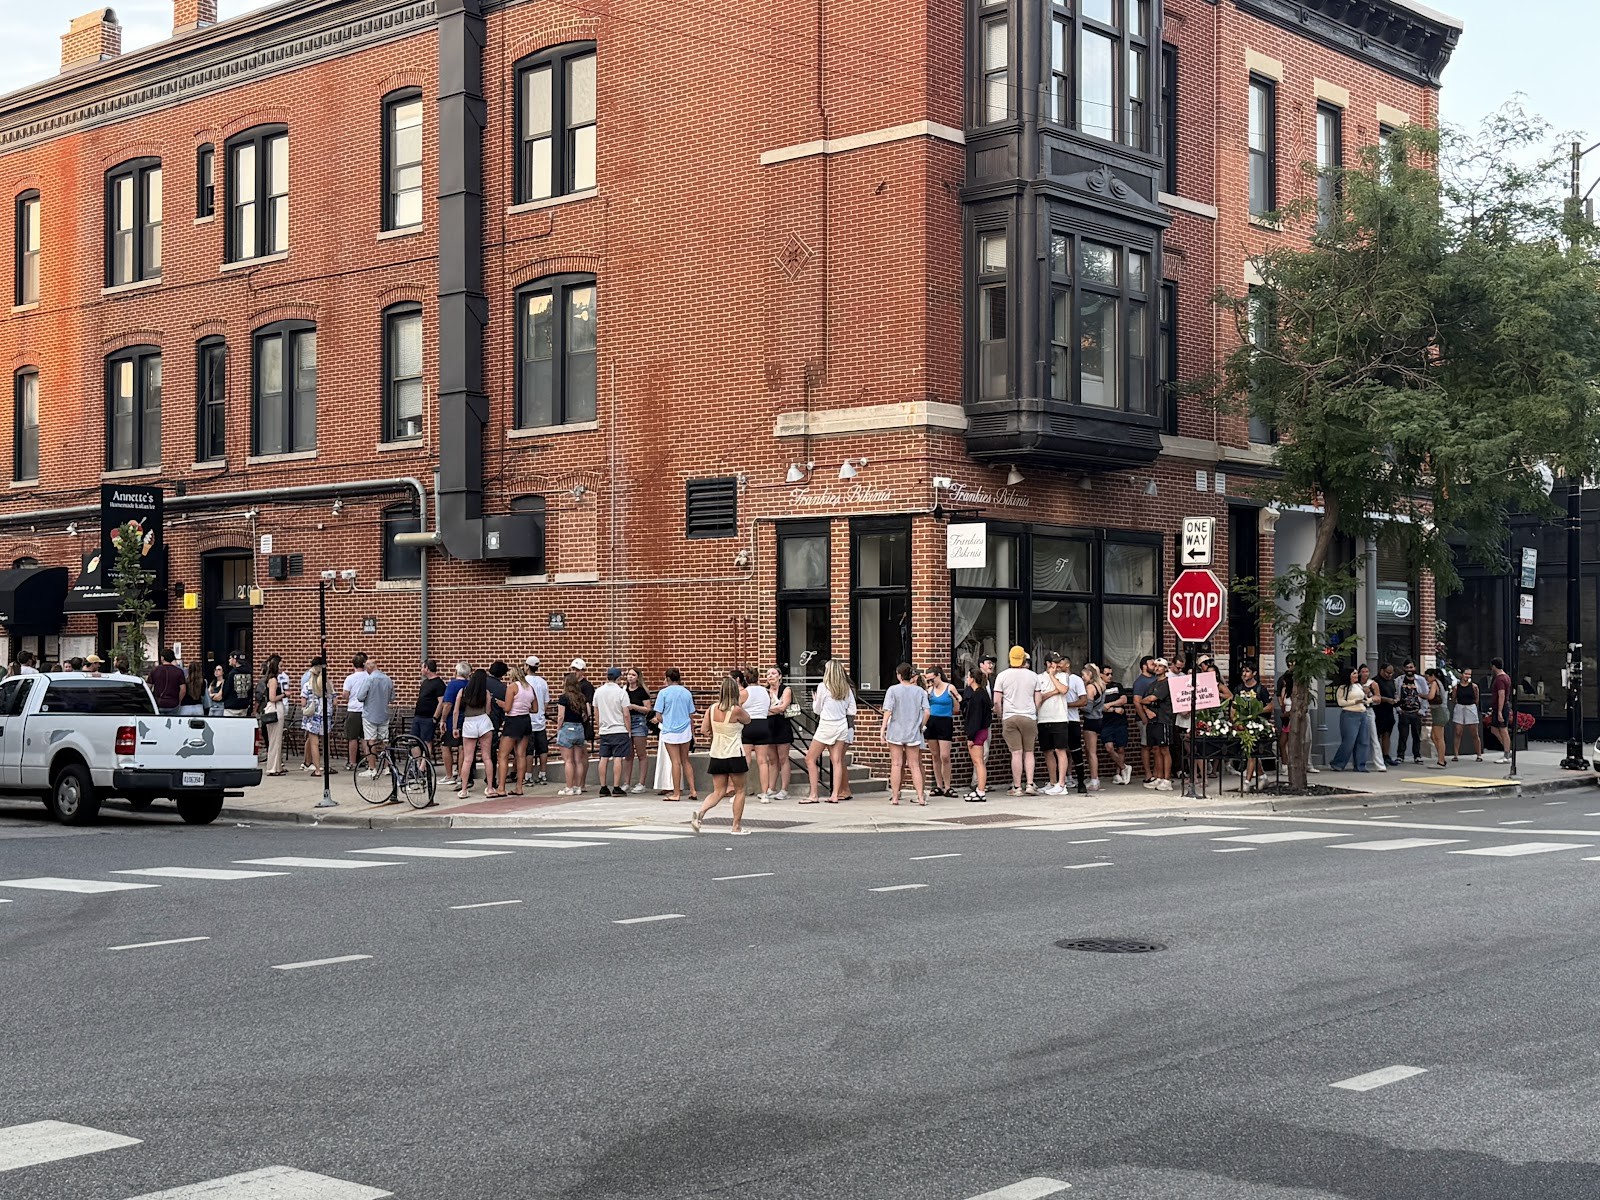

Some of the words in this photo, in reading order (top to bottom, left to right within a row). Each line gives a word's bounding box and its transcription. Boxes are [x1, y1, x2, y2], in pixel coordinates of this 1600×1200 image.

[112, 490, 154, 503] Annette's
[789, 487, 840, 507] Frankies
[843, 484, 892, 503] Bikinis
[949, 483, 992, 504] Frankies
[993, 487, 1030, 507] Bikinis
[1186, 522, 1208, 533] ONE
[950, 533, 984, 546] Frankies
[1186, 534, 1208, 546] WAY
[237, 585, 257, 598] 200
[1171, 591, 1219, 619] STOP
[1324, 598, 1343, 610] Nails
